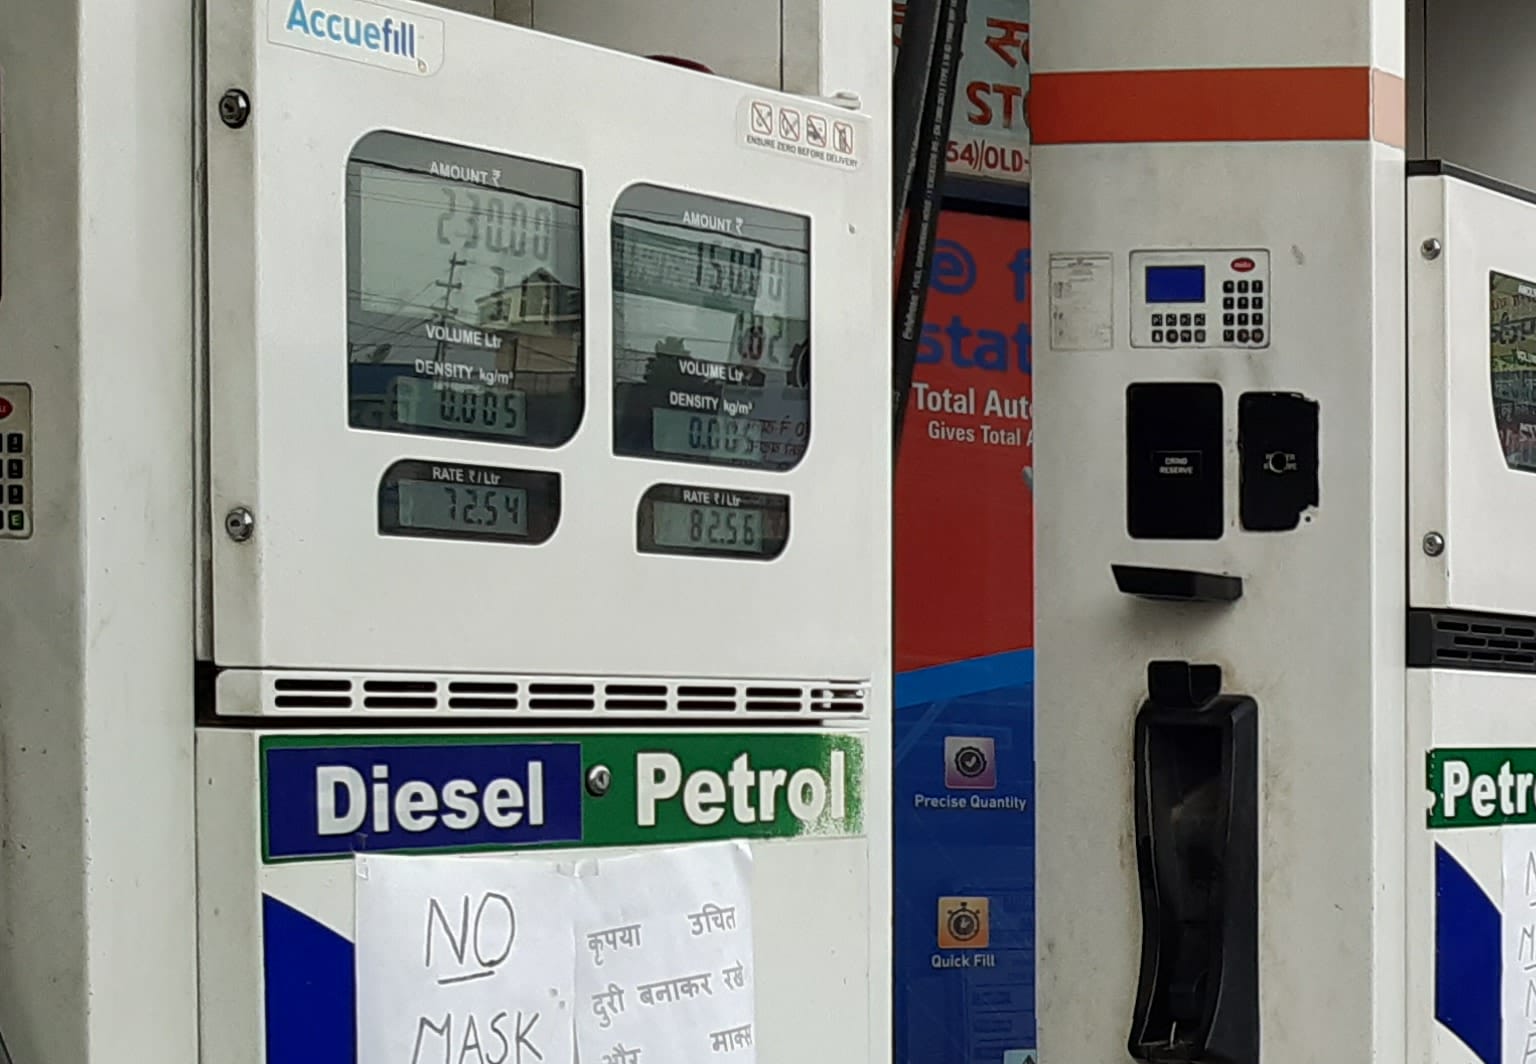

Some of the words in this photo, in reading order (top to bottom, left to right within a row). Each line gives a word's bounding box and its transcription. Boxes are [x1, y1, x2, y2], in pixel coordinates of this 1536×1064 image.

[286, 0, 415, 58] Accuefill
[429, 161, 487, 183] AMOUNT
[682, 210, 731, 232] AMOUNT
[425, 324, 482, 344] VOLUME
[484, 331, 502, 348] Ltr
[415, 359, 473, 379] DENSITY
[679, 359, 726, 380] VOLUME
[669, 391, 719, 411] DENSITY
[912, 382, 975, 416] Total
[928, 420, 975, 442] Gives
[980, 425, 1021, 446] Total
[432, 466, 463, 482] RATE
[683, 490, 710, 504] RATE
[444, 487, 519, 535] 72.54
[690, 509, 755, 545] 82.56
[316, 761, 544, 836] Diesel
[637, 749, 845, 828] Petrol
[914, 794, 967, 809] Precise
[970, 795, 1026, 810] Quantity
[425, 892, 516, 968] NO
[587, 924, 641, 966] कृपया
[688, 904, 735, 936] उचित
[931, 954, 970, 968] Quick
[973, 954, 995, 968] Fill
[637, 973, 712, 1005] बनाकर
